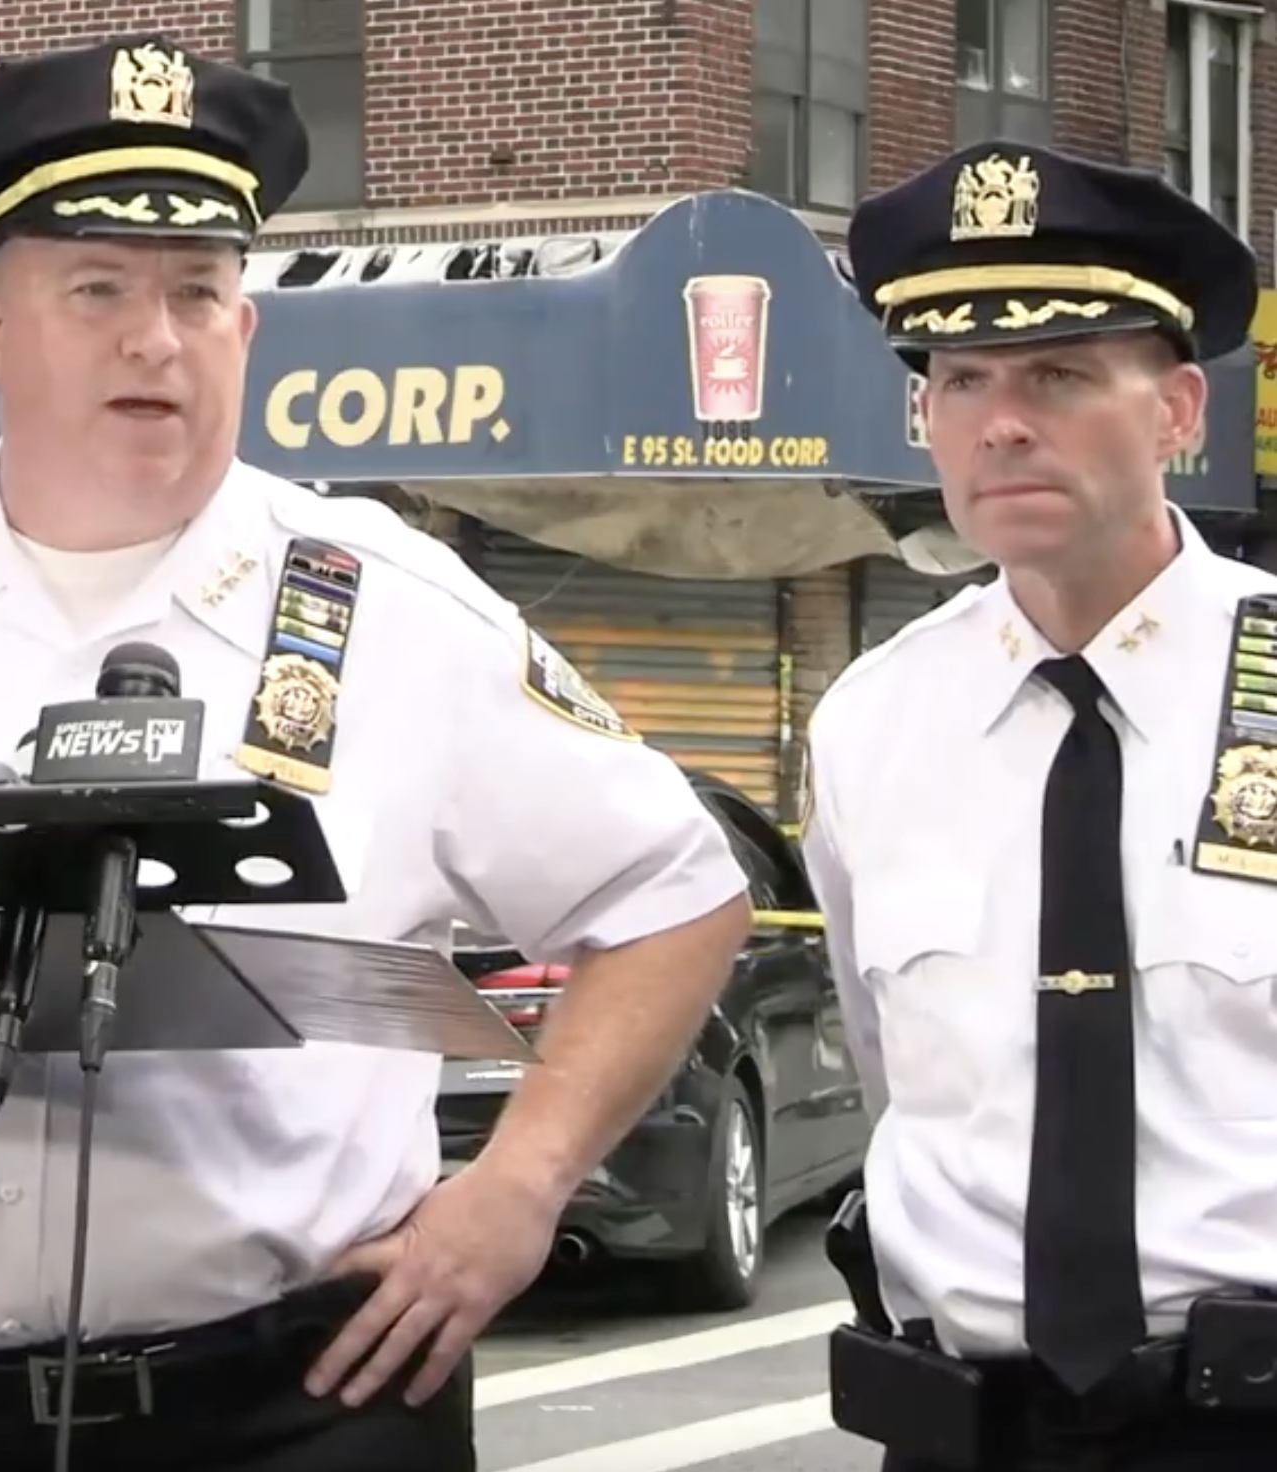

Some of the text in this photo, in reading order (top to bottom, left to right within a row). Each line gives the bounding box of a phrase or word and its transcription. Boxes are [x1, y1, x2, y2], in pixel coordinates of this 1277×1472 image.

[265, 365, 510, 449] CORP.
[624, 436, 636, 464] E
[642, 436, 667, 465] 95
[704, 436, 764, 466] FOOD
[769, 437, 829, 466] CORP.
[55, 719, 126, 735] SPECTRUM
[151, 722, 180, 735] NY
[45, 729, 144, 761] NEWS
